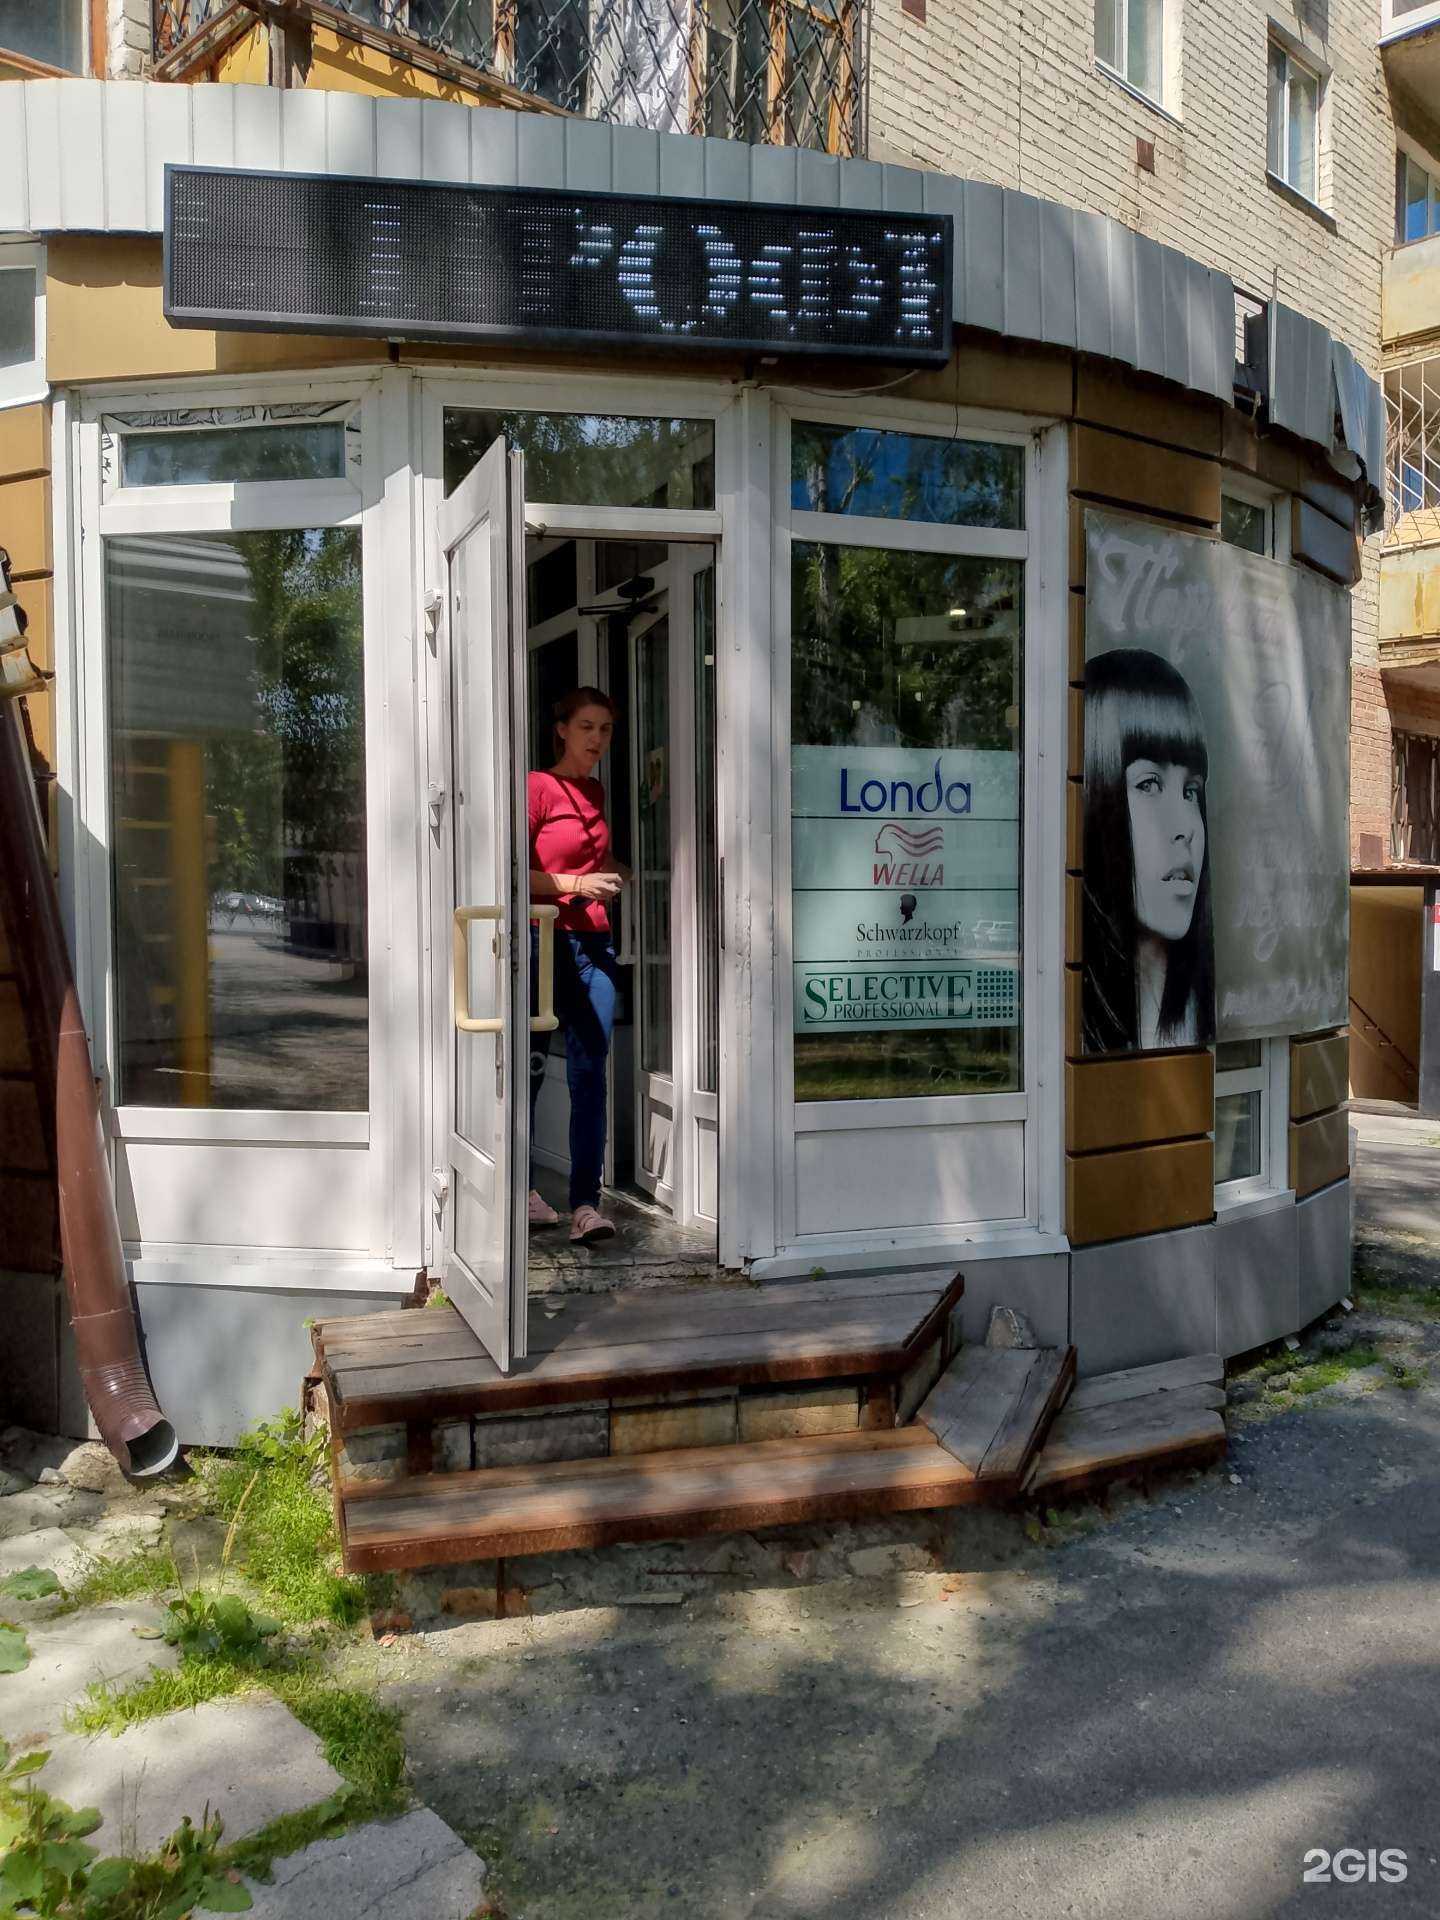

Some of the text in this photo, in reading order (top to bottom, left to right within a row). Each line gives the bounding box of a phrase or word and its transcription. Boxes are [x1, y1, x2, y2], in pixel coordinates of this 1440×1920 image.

[840, 755, 972, 814] Londa
[872, 863, 944, 886] WELLA
[856, 921, 962, 945] Schwarzkopf
[804, 975, 972, 1020] SELECTIVE
[834, 1002, 941, 1019] PROFESSIONAL
